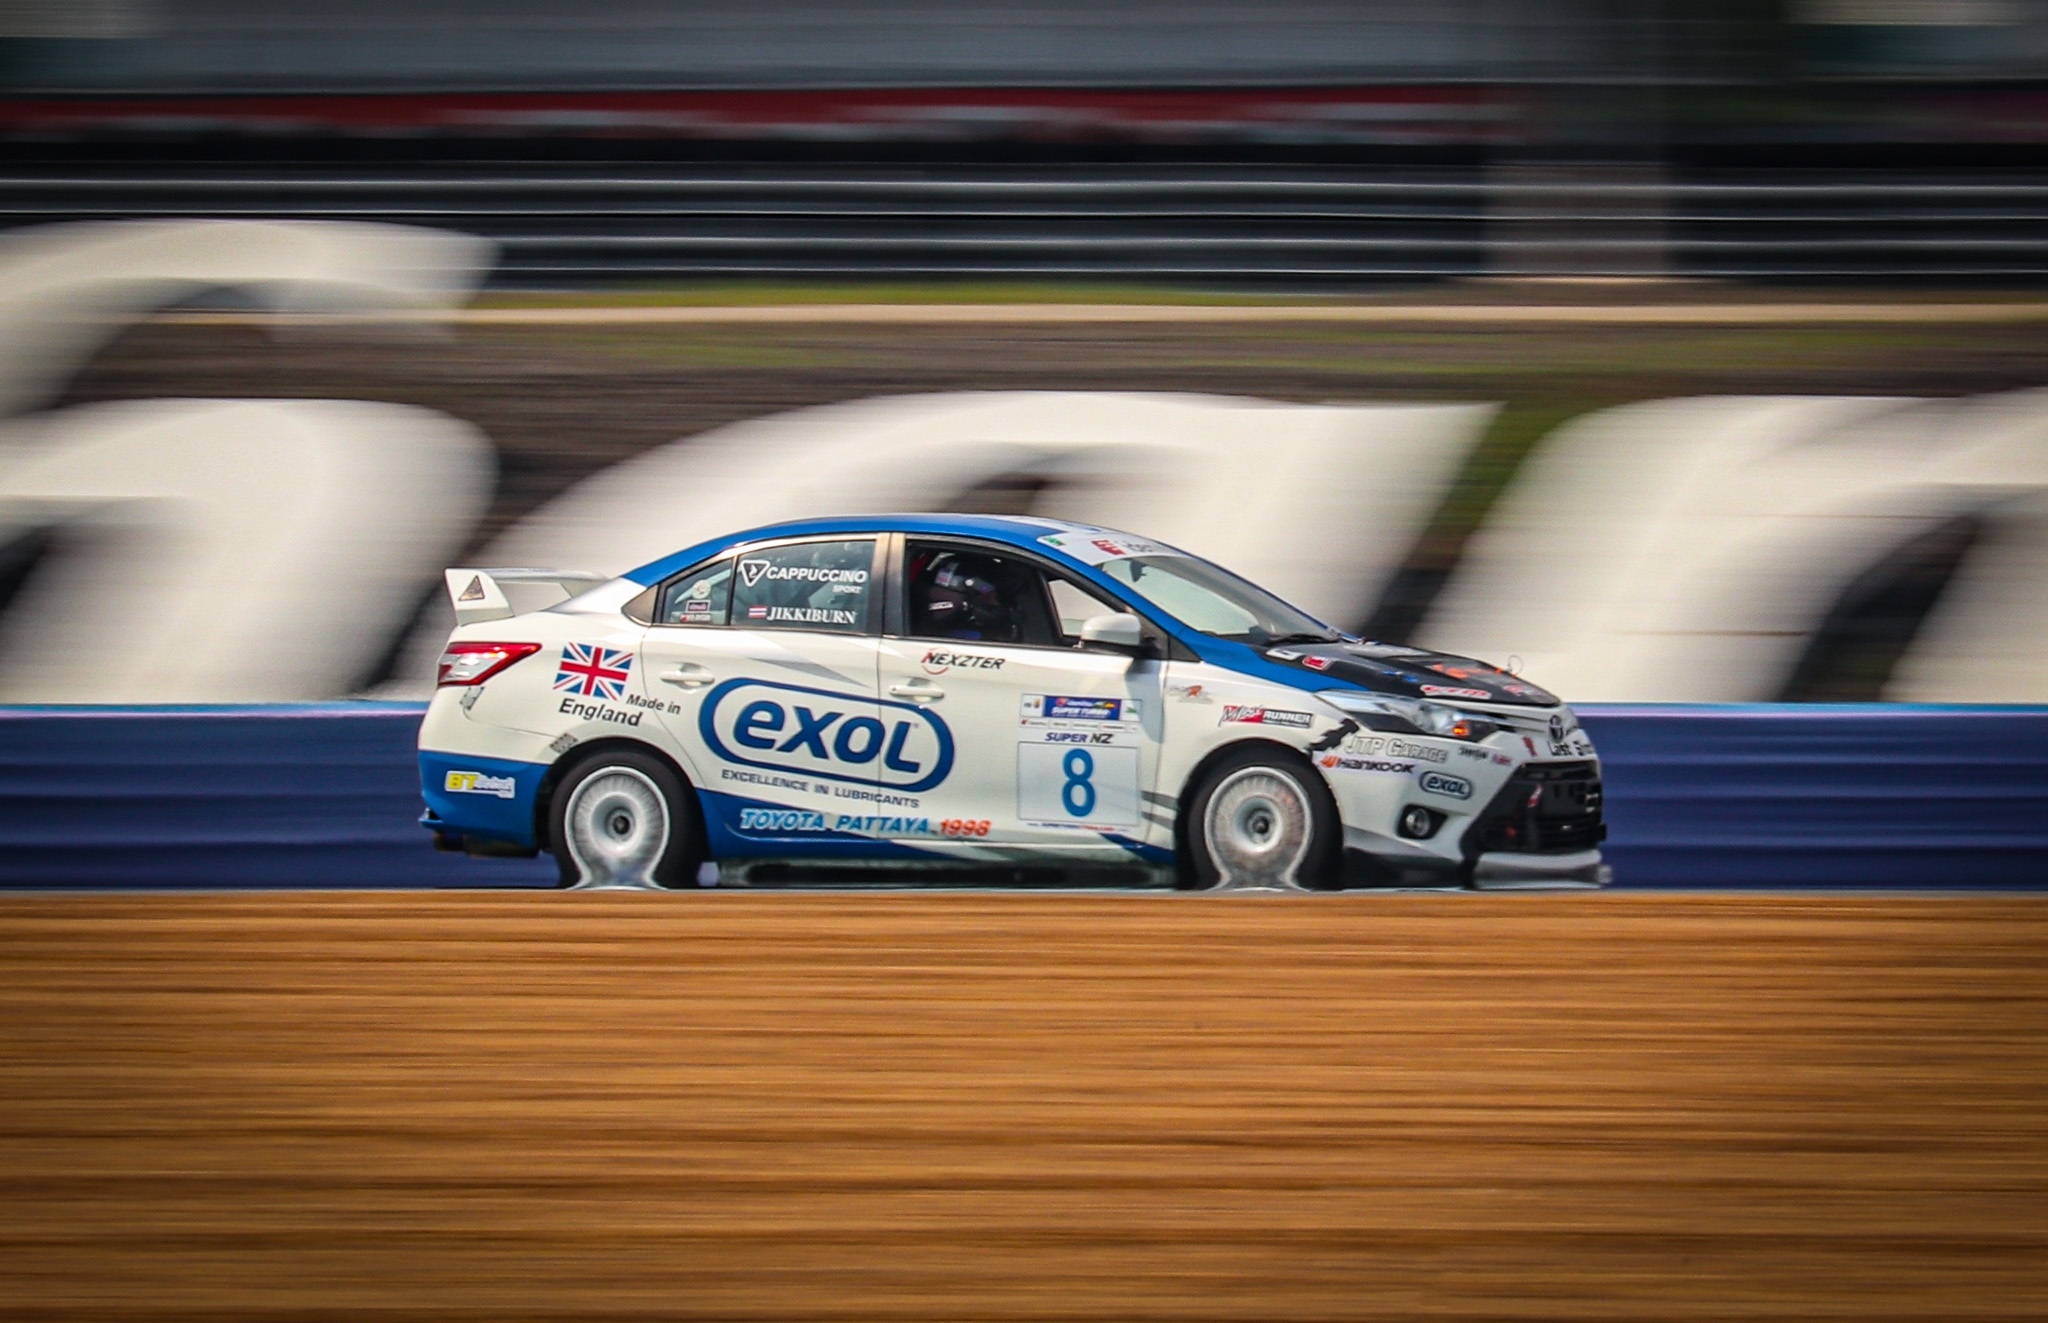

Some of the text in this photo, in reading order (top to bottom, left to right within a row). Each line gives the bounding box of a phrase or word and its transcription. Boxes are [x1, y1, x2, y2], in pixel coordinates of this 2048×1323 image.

[766, 566, 868, 584] CAPPUCCINO
[767, 606, 856, 624] JIKKIBURN
[921, 652, 1006, 669] NEXZTER
[558, 698, 643, 726] England
[626, 694, 681, 715] Made in
[1045, 732, 1088, 743] SUPER
[1344, 735, 1384, 755] JTP
[721, 769, 920, 808] EXCELLENCE IN LUBRICANTS
[1062, 748, 1096, 818] 8
[740, 807, 992, 837] TOYOTA PATTAYA 1998
